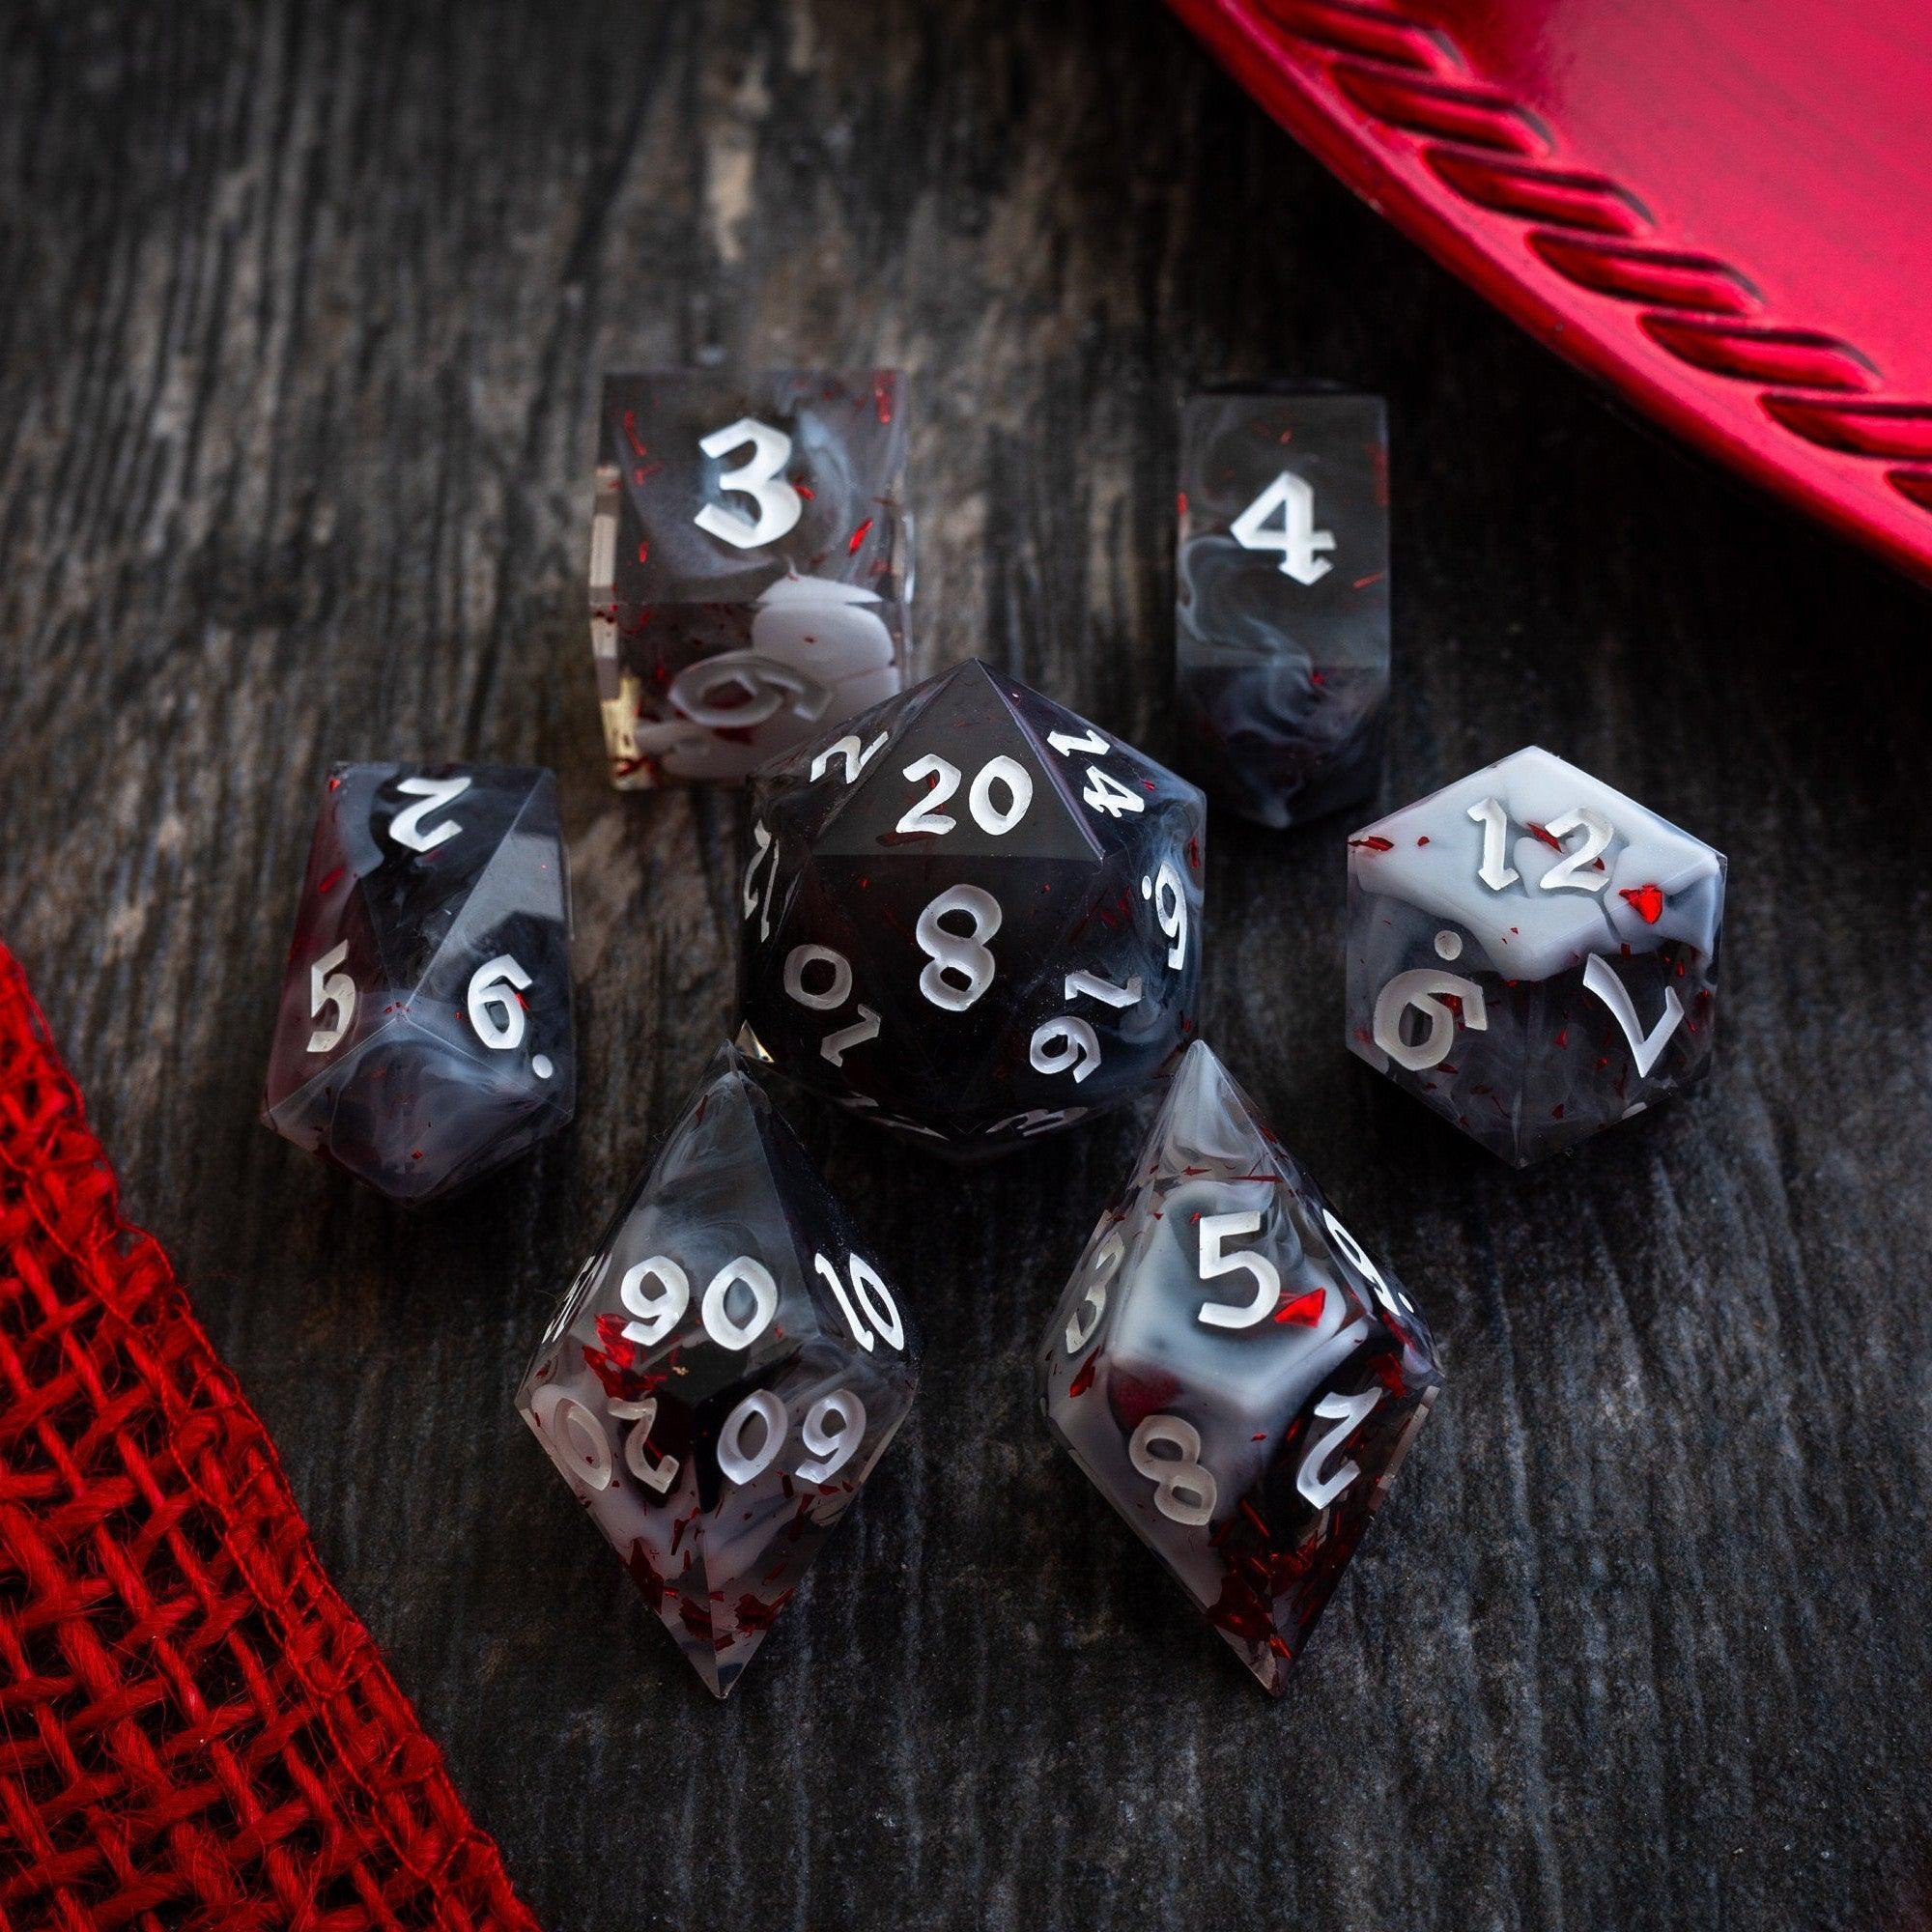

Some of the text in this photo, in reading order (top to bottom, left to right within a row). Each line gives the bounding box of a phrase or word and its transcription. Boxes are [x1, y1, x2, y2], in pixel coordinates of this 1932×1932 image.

[694, 417, 802, 549] 3
[1230, 470, 1336, 586] 4
[810, 730, 890, 784] 2
[895, 753, 1034, 836] 20
[389, 777, 471, 852] 2
[1466, 798, 1614, 892] 12
[306, 938, 355, 1052] 5
[915, 883, 1003, 1012] 8
[1582, 953, 1685, 1077] 7
[620, 1255, 778, 1350] 90
[814, 1253, 905, 1351] 10
[1198, 1210, 1282, 1328] 5
[1128, 1414, 1218, 1526] 8
[1297, 1388, 1382, 1510] 2
